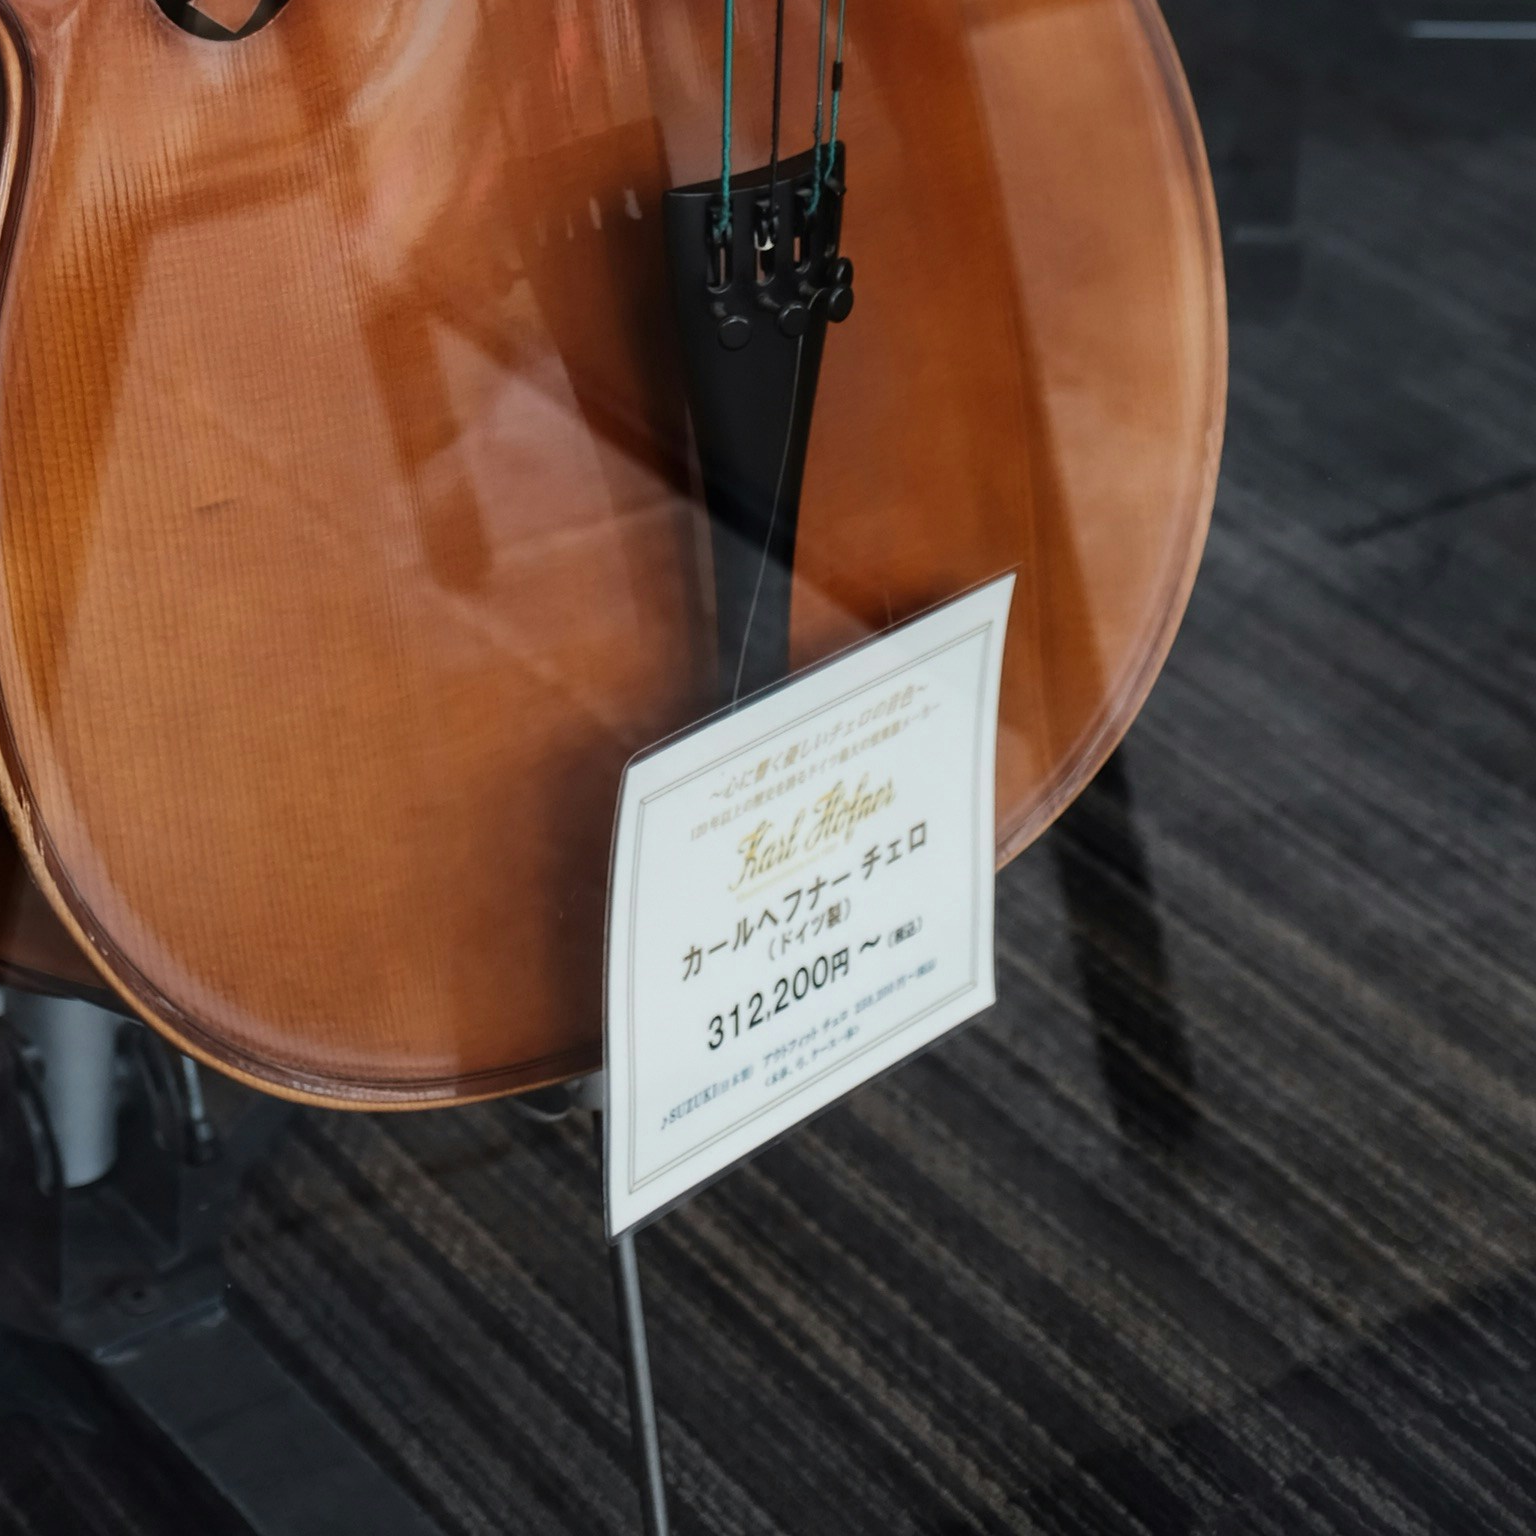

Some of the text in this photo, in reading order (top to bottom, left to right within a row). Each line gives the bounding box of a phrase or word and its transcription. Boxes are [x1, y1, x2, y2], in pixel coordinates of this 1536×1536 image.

[681, 871, 851, 982] カールヘフナー
[861, 819, 928, 881] チェロ
[727, 807, 806, 892] Karl
[707, 946, 850, 1051] 312,200円
